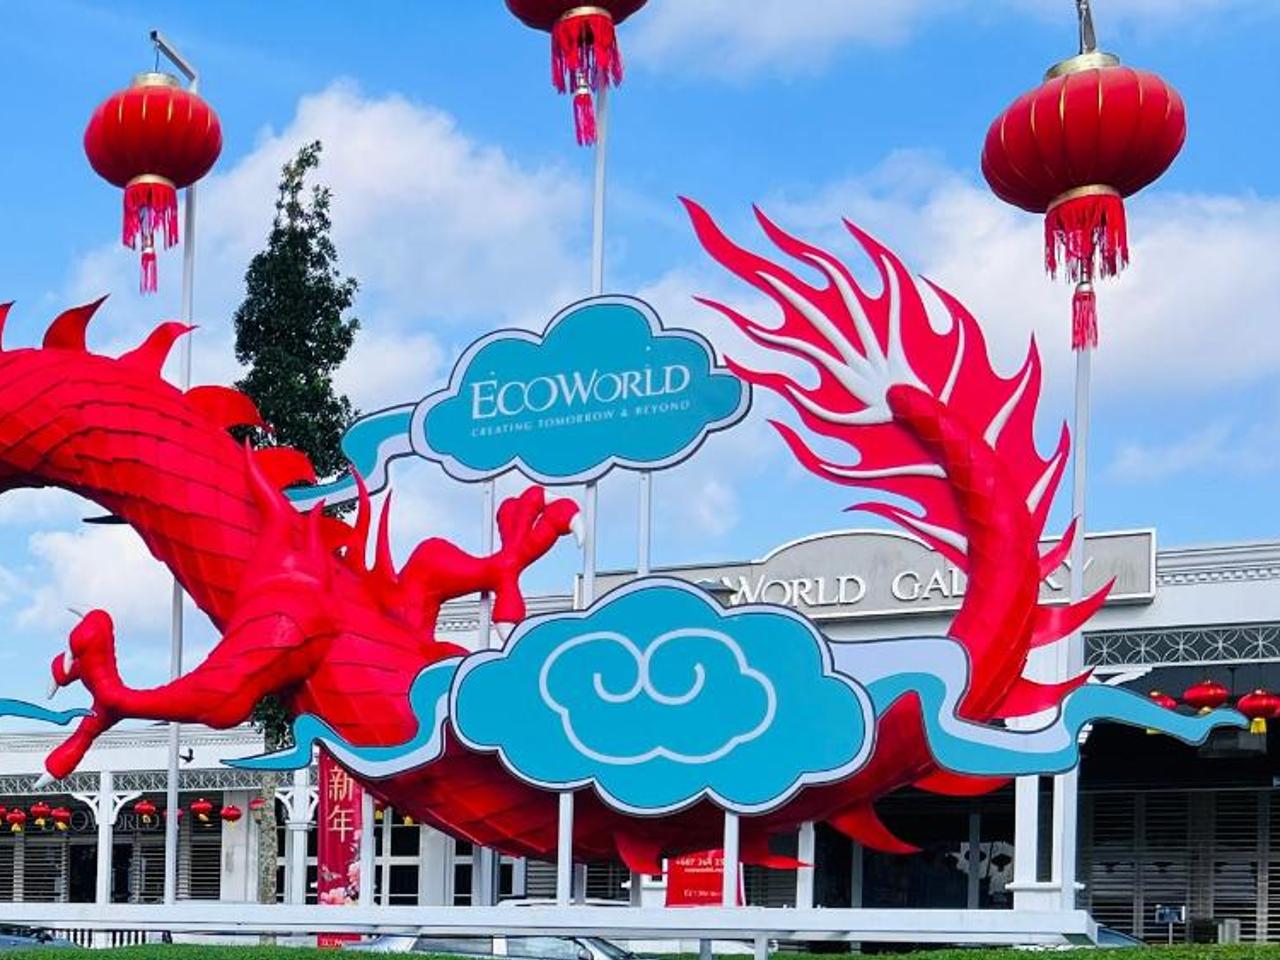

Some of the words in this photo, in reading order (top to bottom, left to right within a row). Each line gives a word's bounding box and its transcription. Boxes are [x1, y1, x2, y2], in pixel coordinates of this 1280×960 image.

[472, 421, 533, 437] CREATING
[539, 411, 615, 429] TOMORROW
[635, 400, 691, 416] BEYOND
[327, 765, 355, 843] 新年
